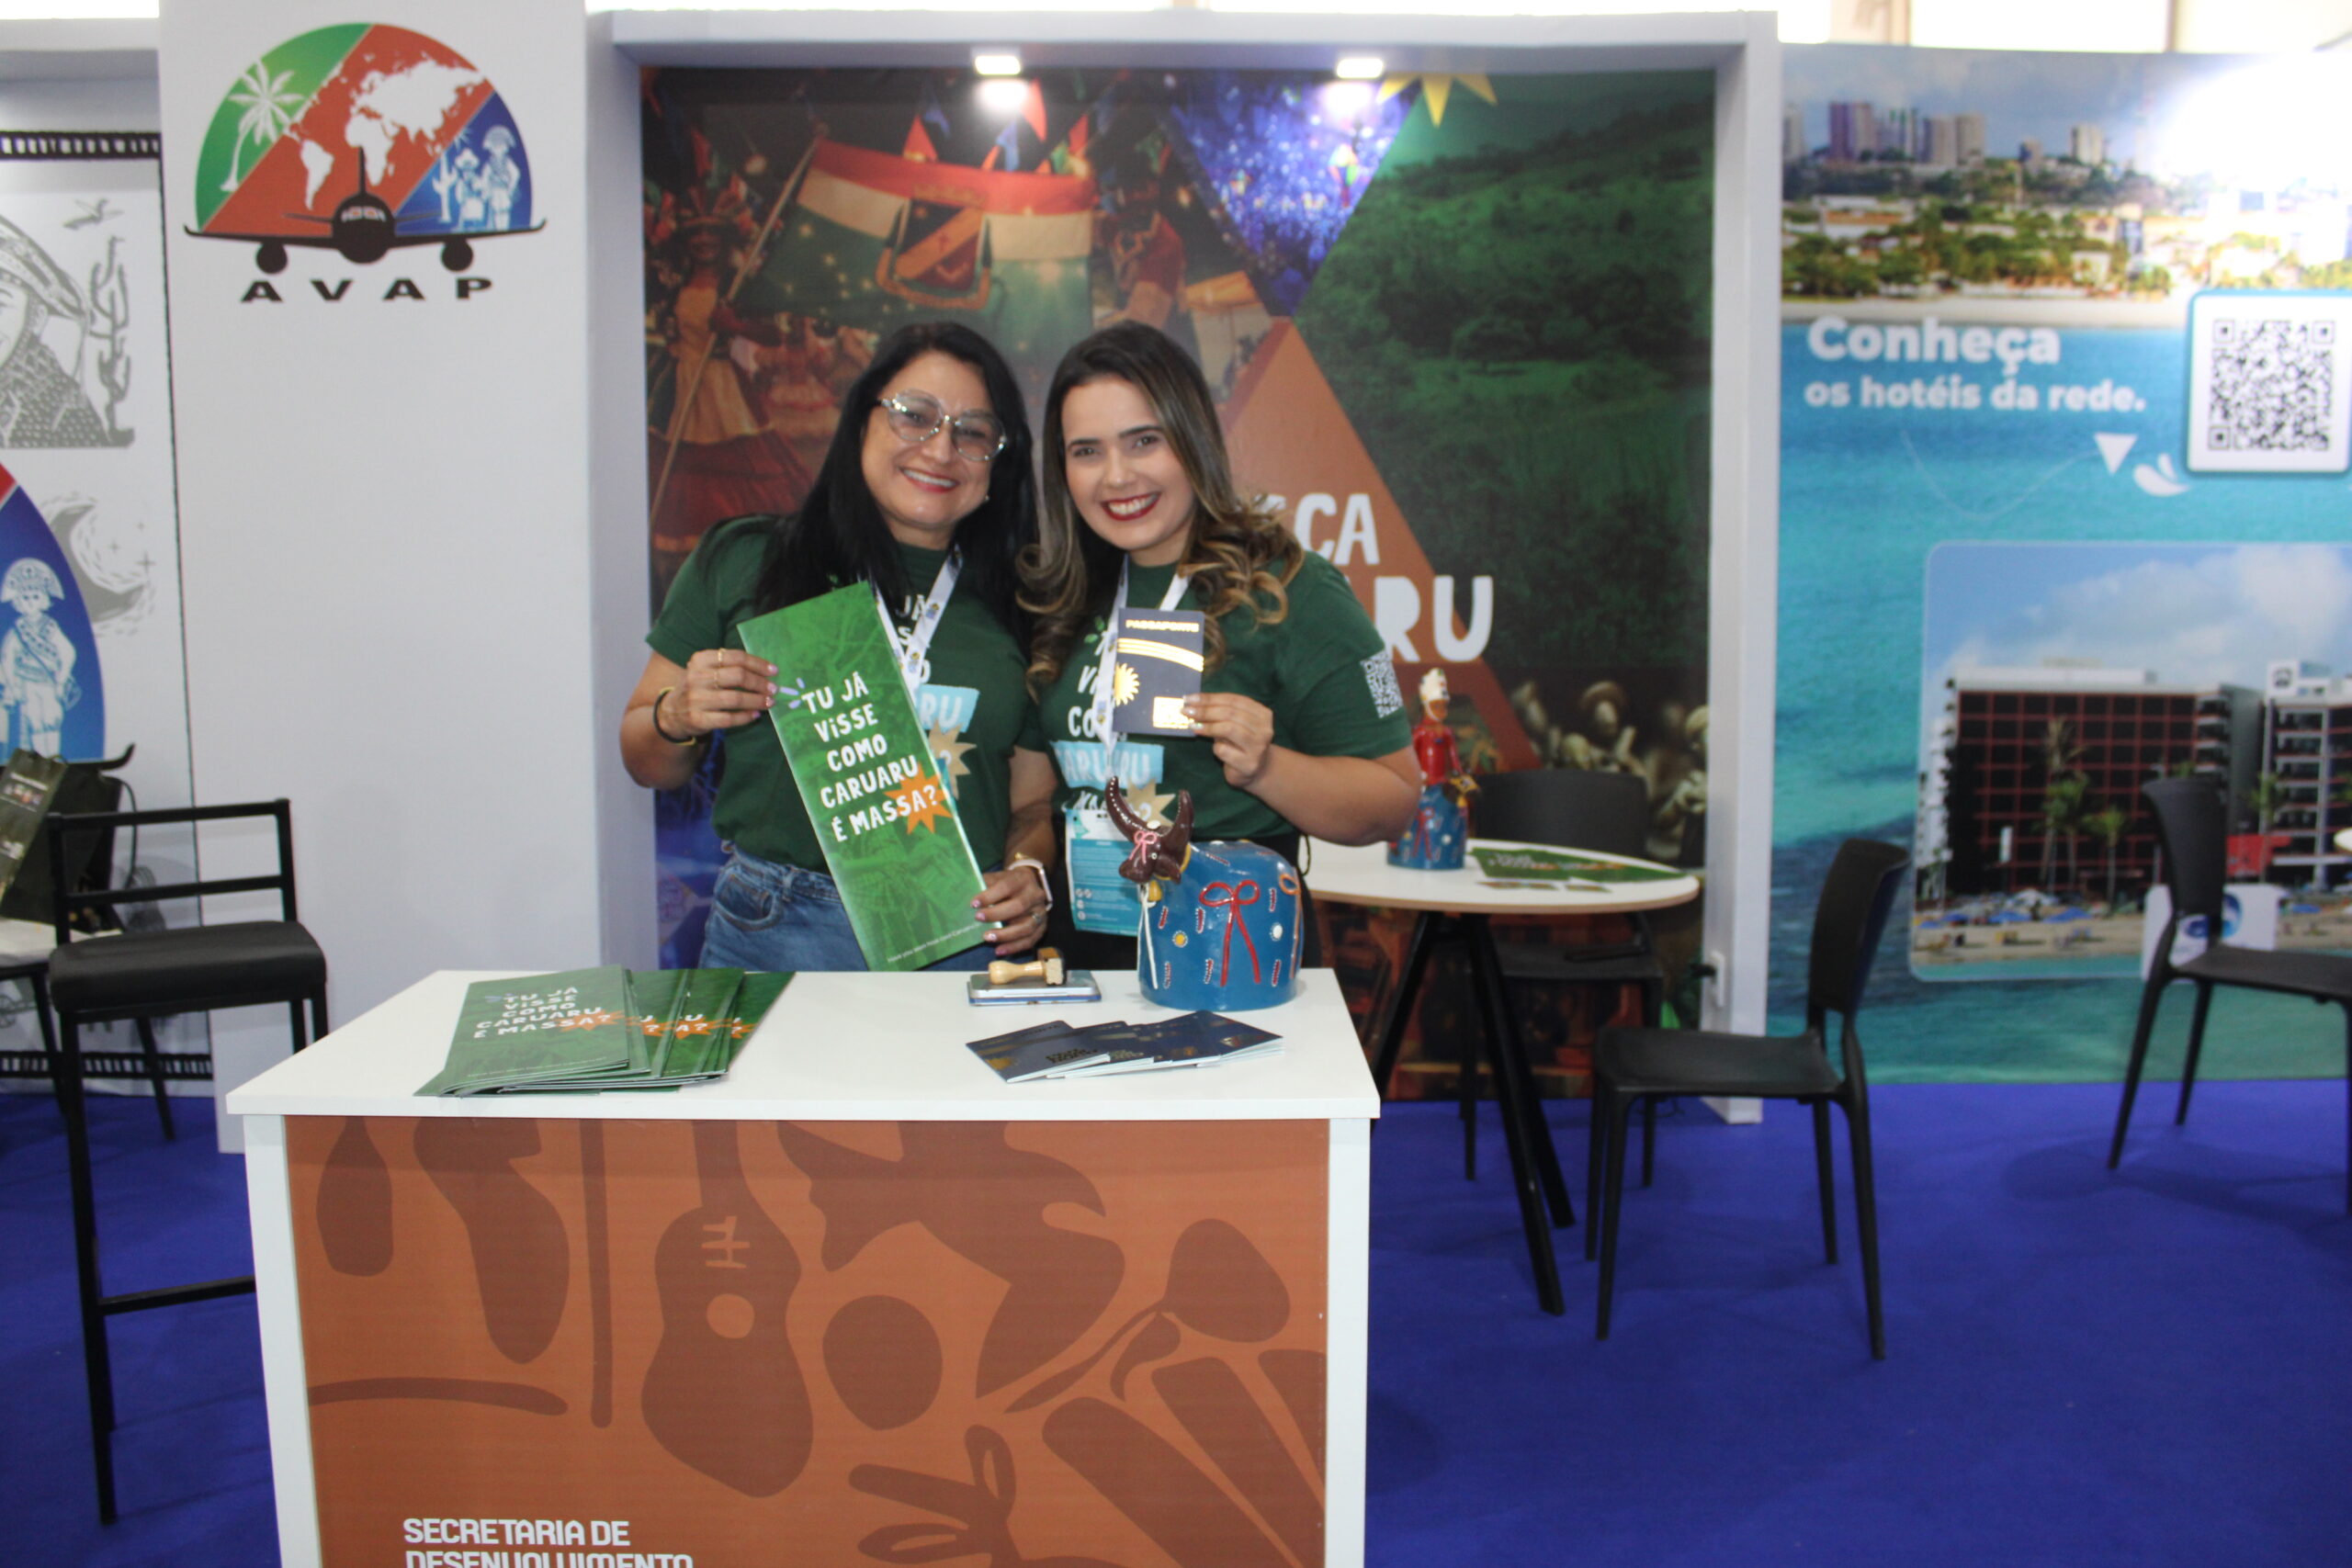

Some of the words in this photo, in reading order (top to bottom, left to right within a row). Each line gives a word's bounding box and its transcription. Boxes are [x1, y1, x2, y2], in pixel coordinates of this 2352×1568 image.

[241, 278, 492, 302] AVAP
[1807, 316, 2061, 377] Conheça
[1804, 381, 1849, 408] os
[1860, 374, 1982, 410] hotéis
[1990, 378, 2039, 411] da
[2048, 379, 2146, 412] rede.
[801, 686, 834, 715] TU
[841, 671, 869, 702] JÁ
[826, 733, 888, 773] COMO
[820, 754, 919, 809] CARUARU
[848, 784, 937, 836] MASSA?
[502, 1002, 576, 1019] COMO
[503, 992, 538, 1003] TU
[476, 1006, 603, 1030] CARUARU
[497, 1014, 612, 1036] MASSA?
[402, 1518, 585, 1546] SECRETARIA
[591, 1520, 631, 1546] DE
